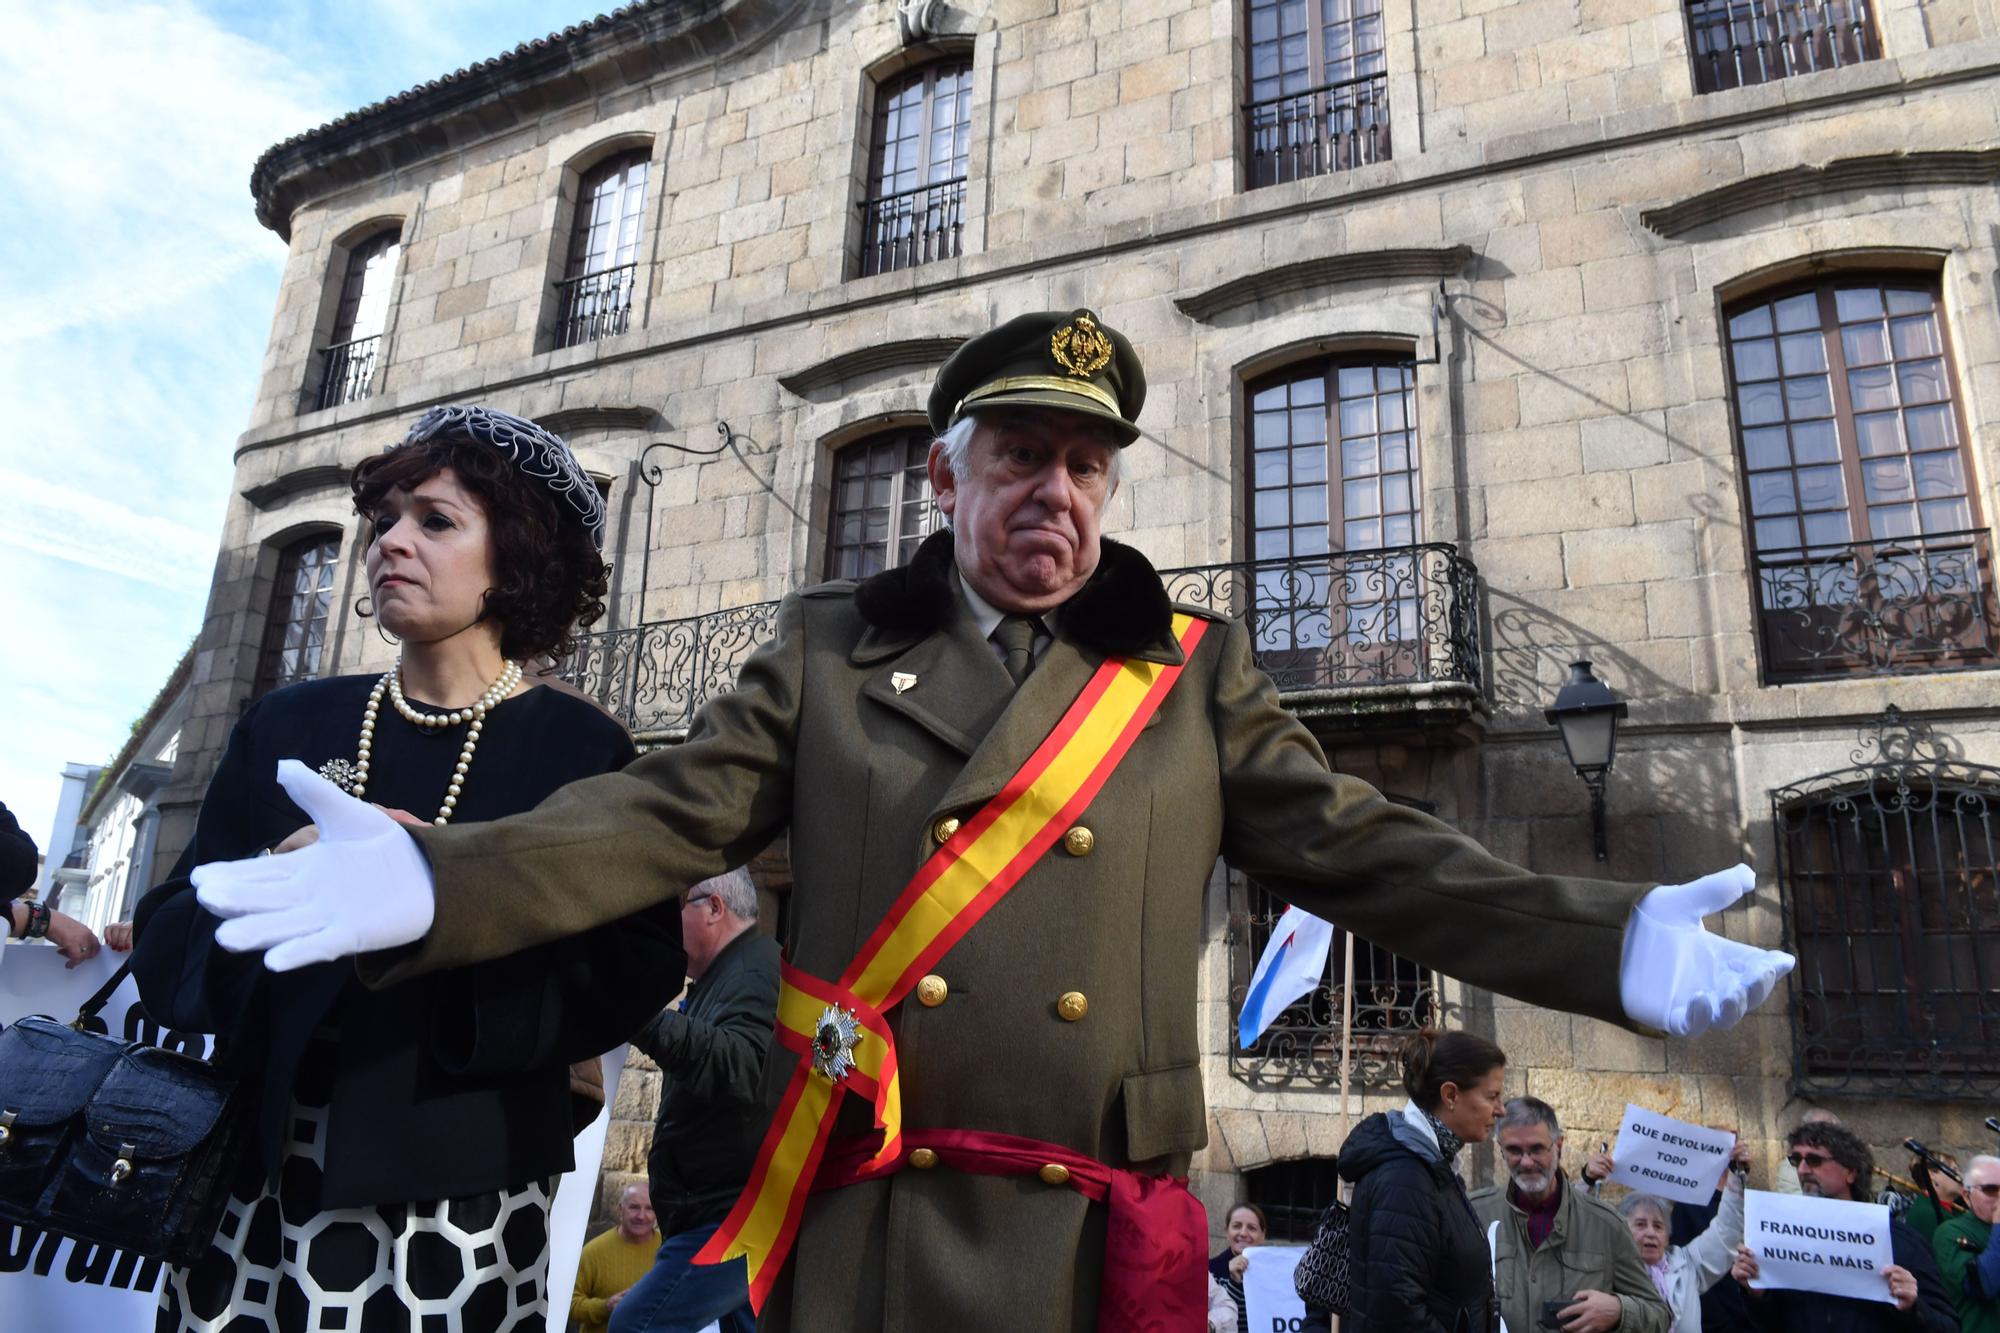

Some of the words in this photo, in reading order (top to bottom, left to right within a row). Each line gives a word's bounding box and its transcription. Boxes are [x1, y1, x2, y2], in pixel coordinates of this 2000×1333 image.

[1632, 1123, 1659, 1140] QUE
[1662, 1133, 1724, 1155] DEVOLVAN
[1657, 1151, 1688, 1167] TODO
[1630, 1164, 1639, 1173] O
[1641, 1167, 1699, 1189] ROUBADO
[1760, 1220, 1875, 1246] FRANQUISMO
[1763, 1247, 1825, 1265] NUNCA
[1829, 1255, 1875, 1271] MÁIS
